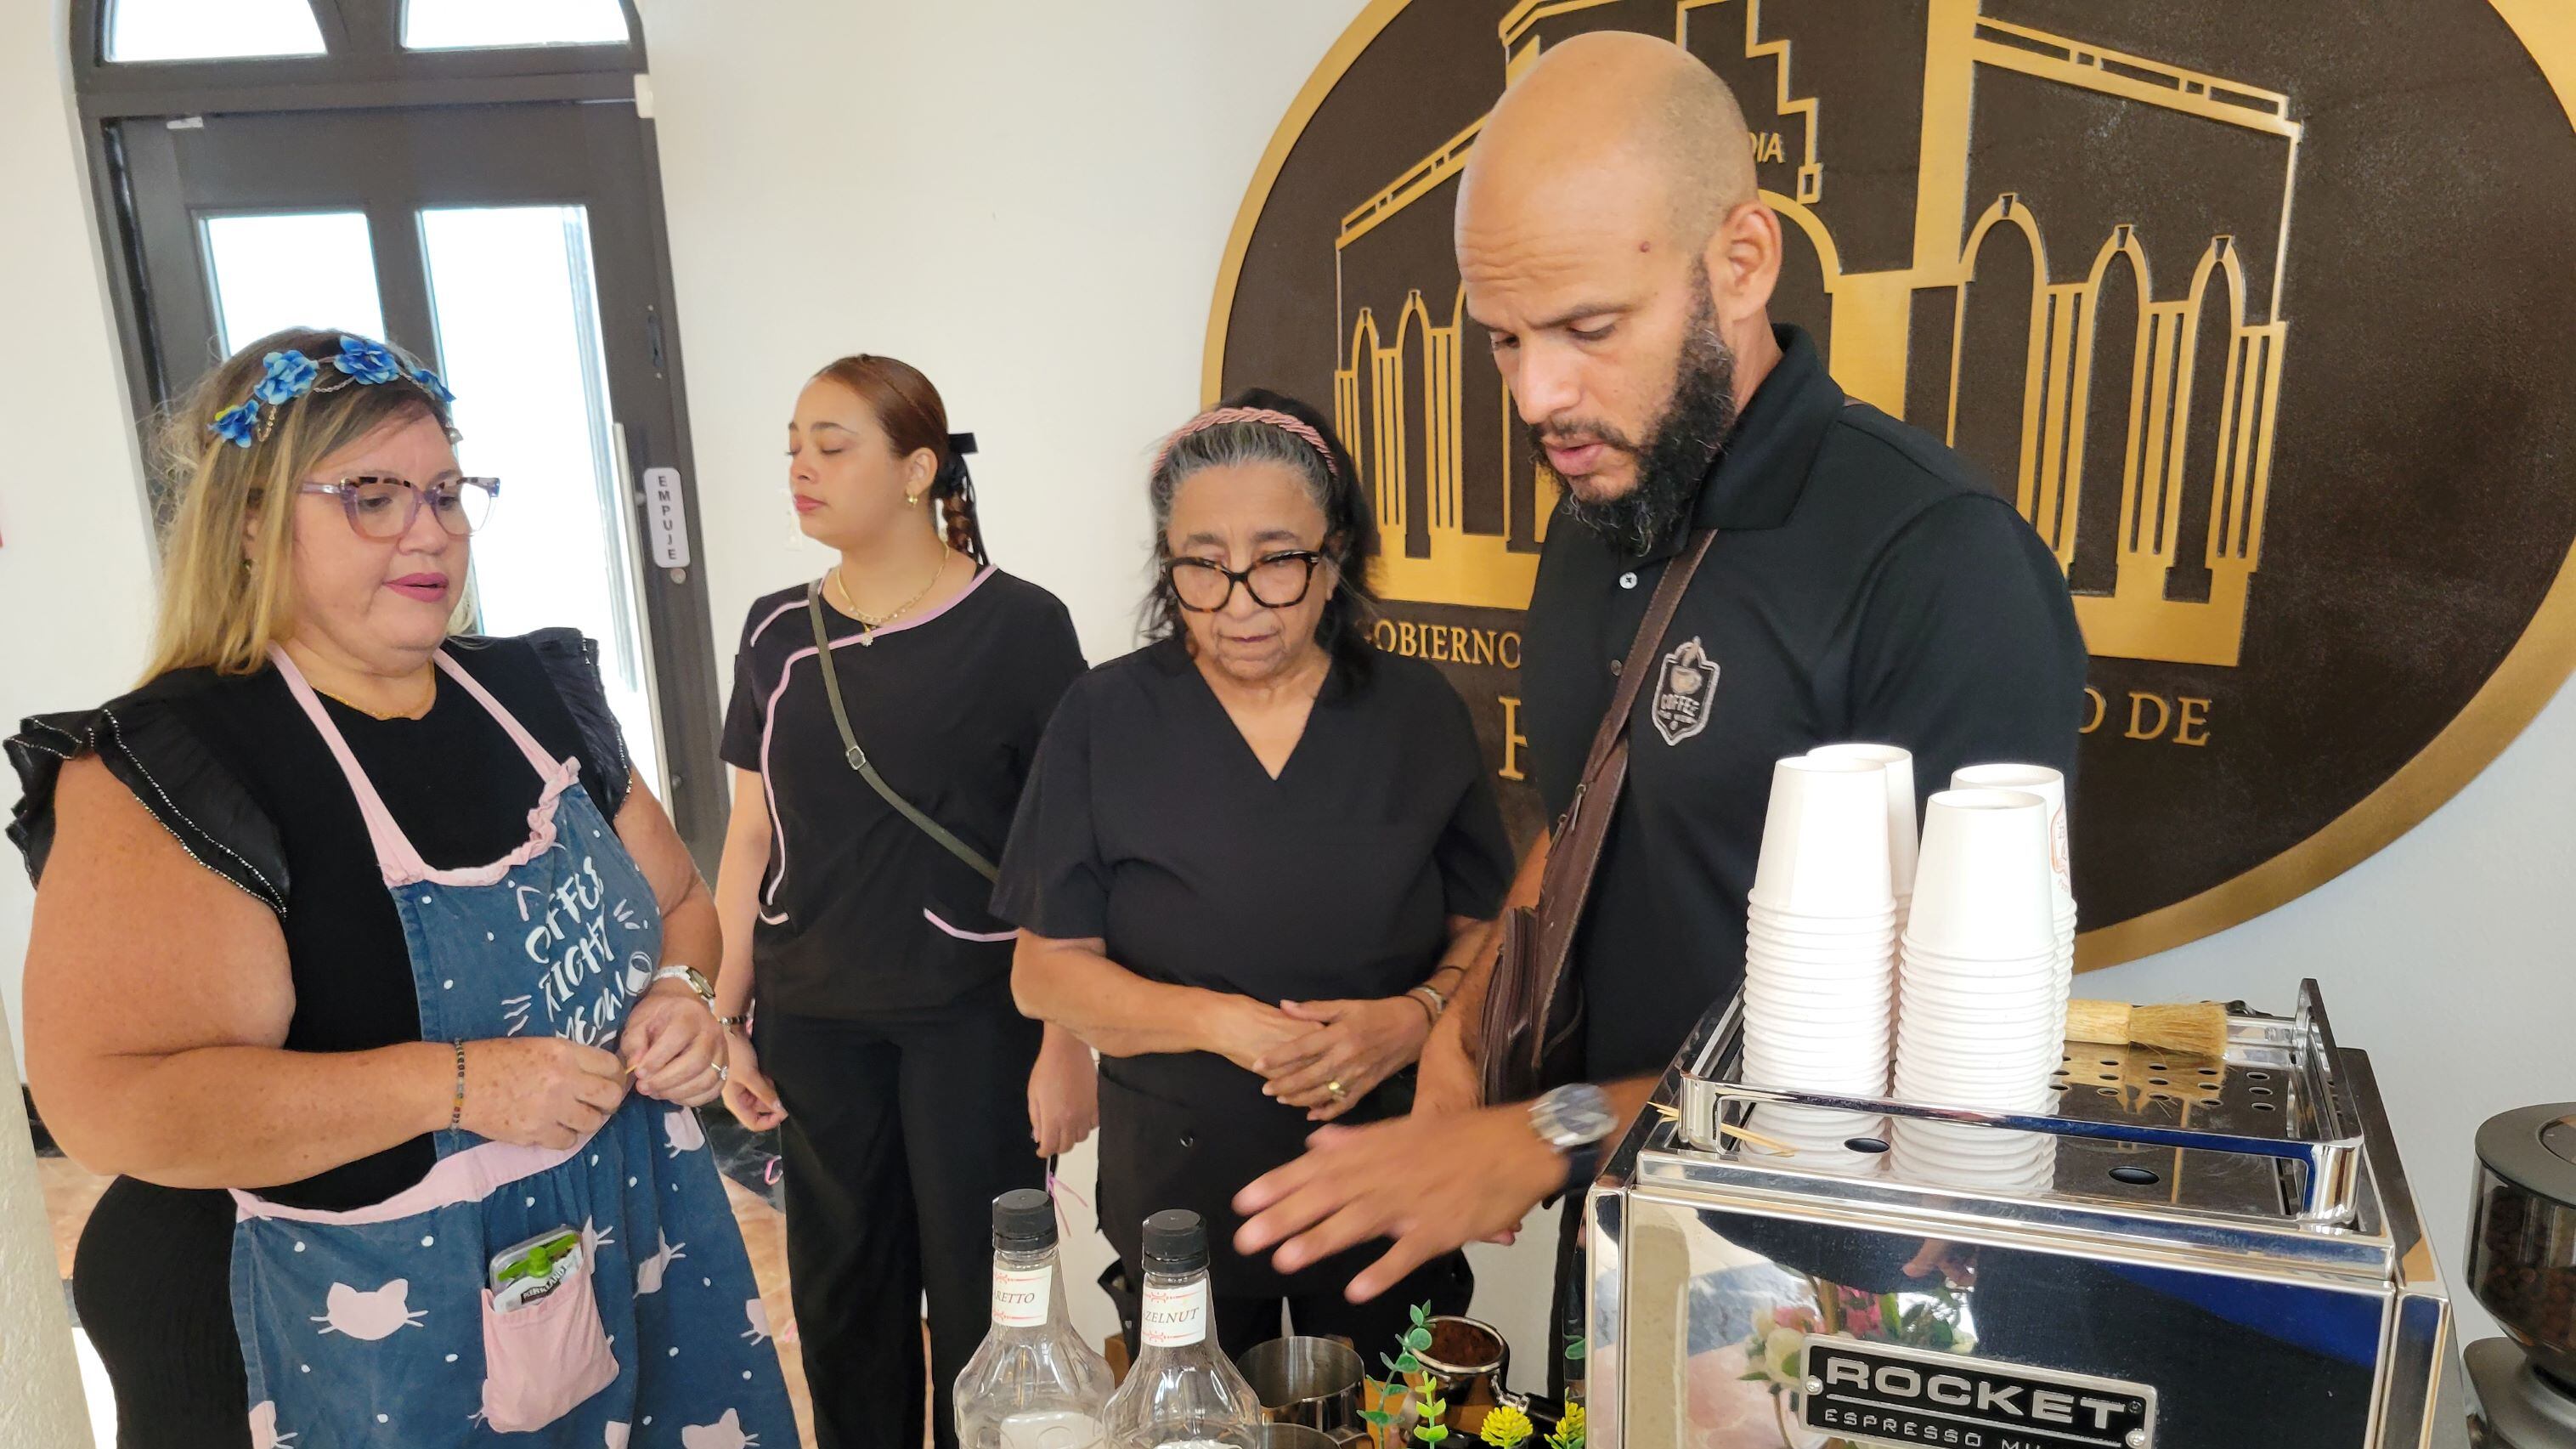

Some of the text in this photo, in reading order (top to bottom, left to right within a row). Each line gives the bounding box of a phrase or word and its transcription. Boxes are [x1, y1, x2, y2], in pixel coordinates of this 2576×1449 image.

[658, 475, 678, 560] EMPUJE
[1364, 619, 1521, 669] OBIERNO
[2124, 691, 2212, 746] DE
[993, 1290, 1035, 1305] RETTO
[1143, 1307, 1200, 1324] ZELNUT
[1826, 1356, 2126, 1429] ROCKET
[1825, 1408, 1982, 1448] ESPRESSO
